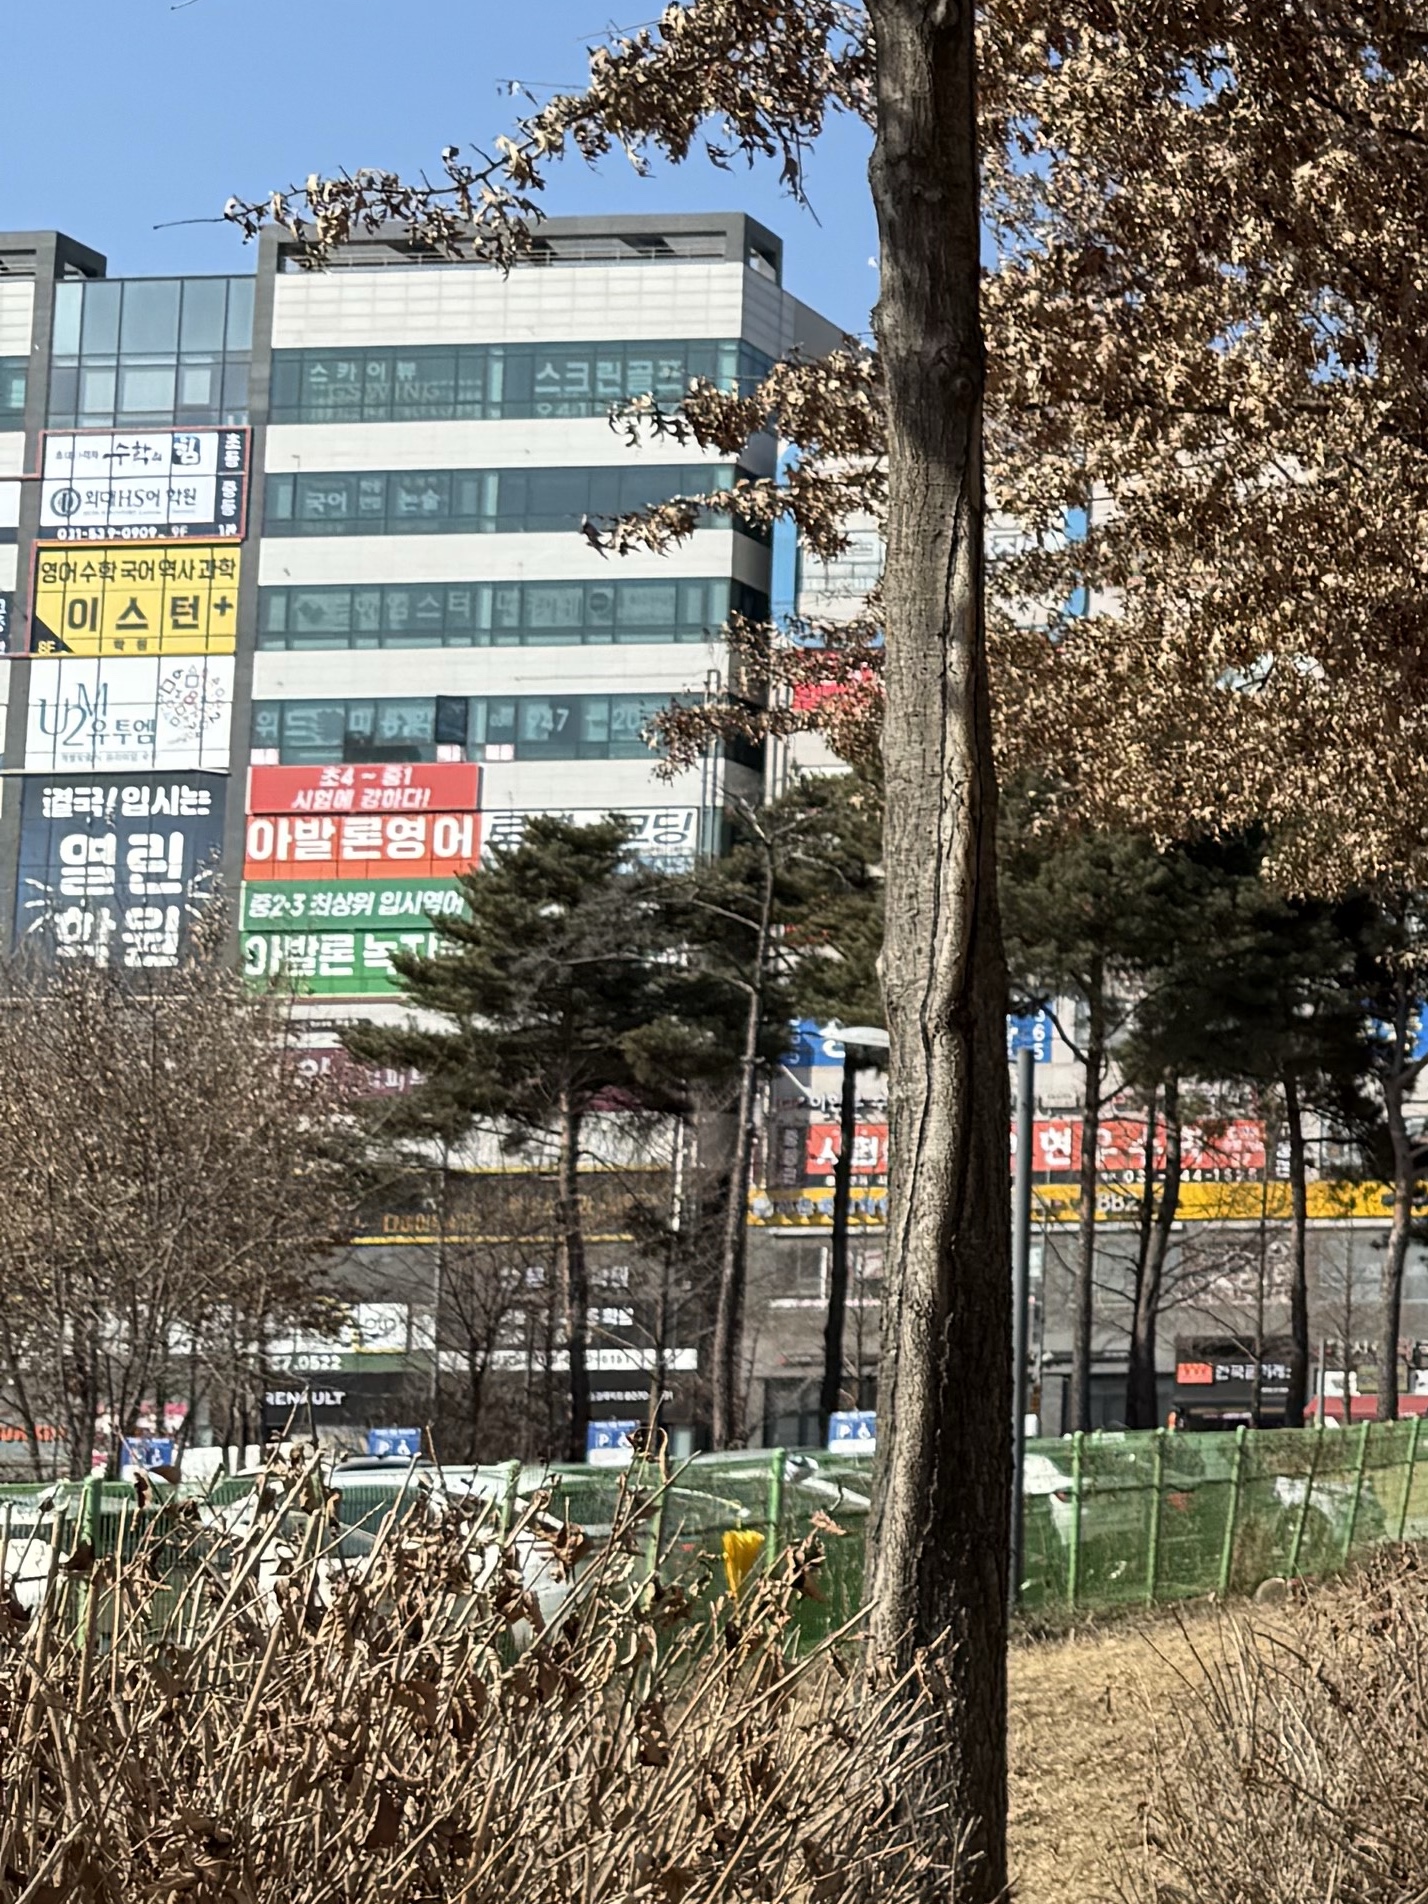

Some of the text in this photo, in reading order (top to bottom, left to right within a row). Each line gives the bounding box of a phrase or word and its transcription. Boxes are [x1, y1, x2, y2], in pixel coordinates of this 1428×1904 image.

[534, 360, 683, 393] 스크린골프
[86, 718, 157, 745] 유투엠
[121, 784, 212, 817] 입시는
[248, 813, 474, 861] 아발론영어
[59, 831, 184, 896] 열린
